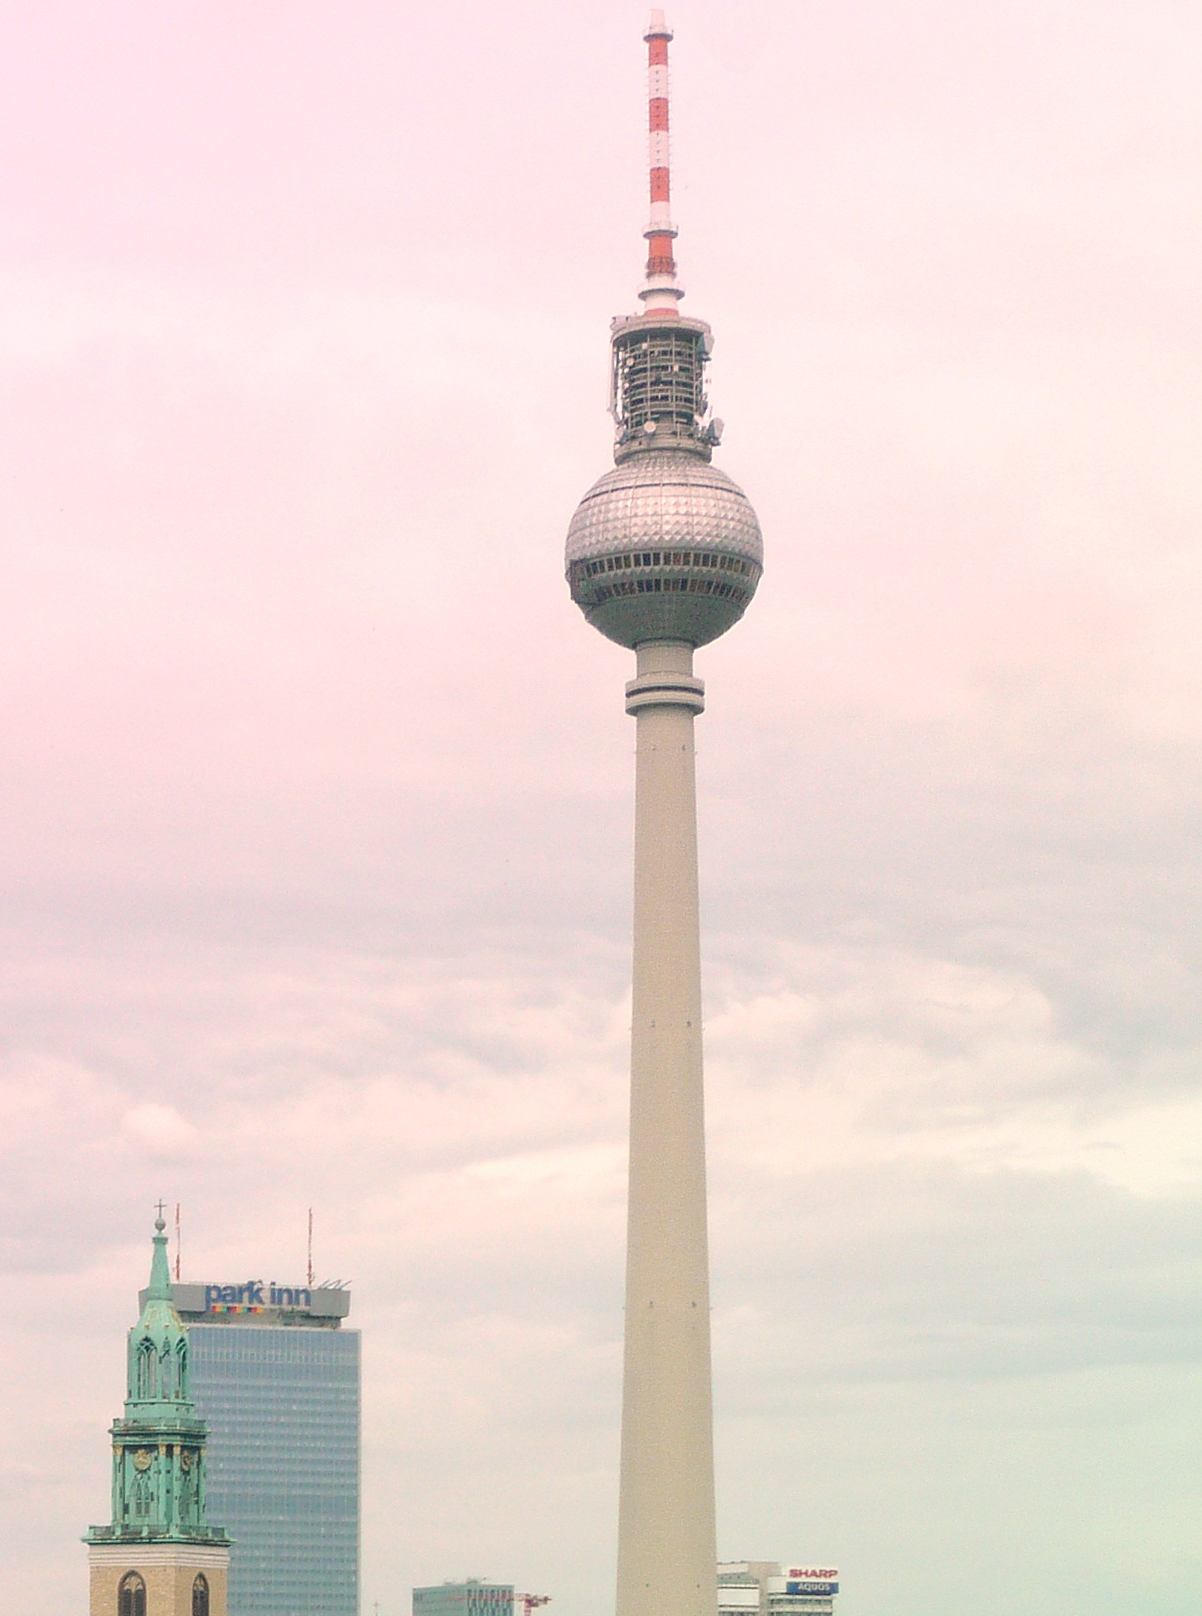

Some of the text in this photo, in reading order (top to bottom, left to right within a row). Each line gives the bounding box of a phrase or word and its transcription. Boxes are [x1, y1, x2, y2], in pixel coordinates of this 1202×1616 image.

[205, 1281, 311, 1312] park inn
[789, 1569, 838, 1578] SHARP
[798, 1582, 831, 1592] AQUOS
